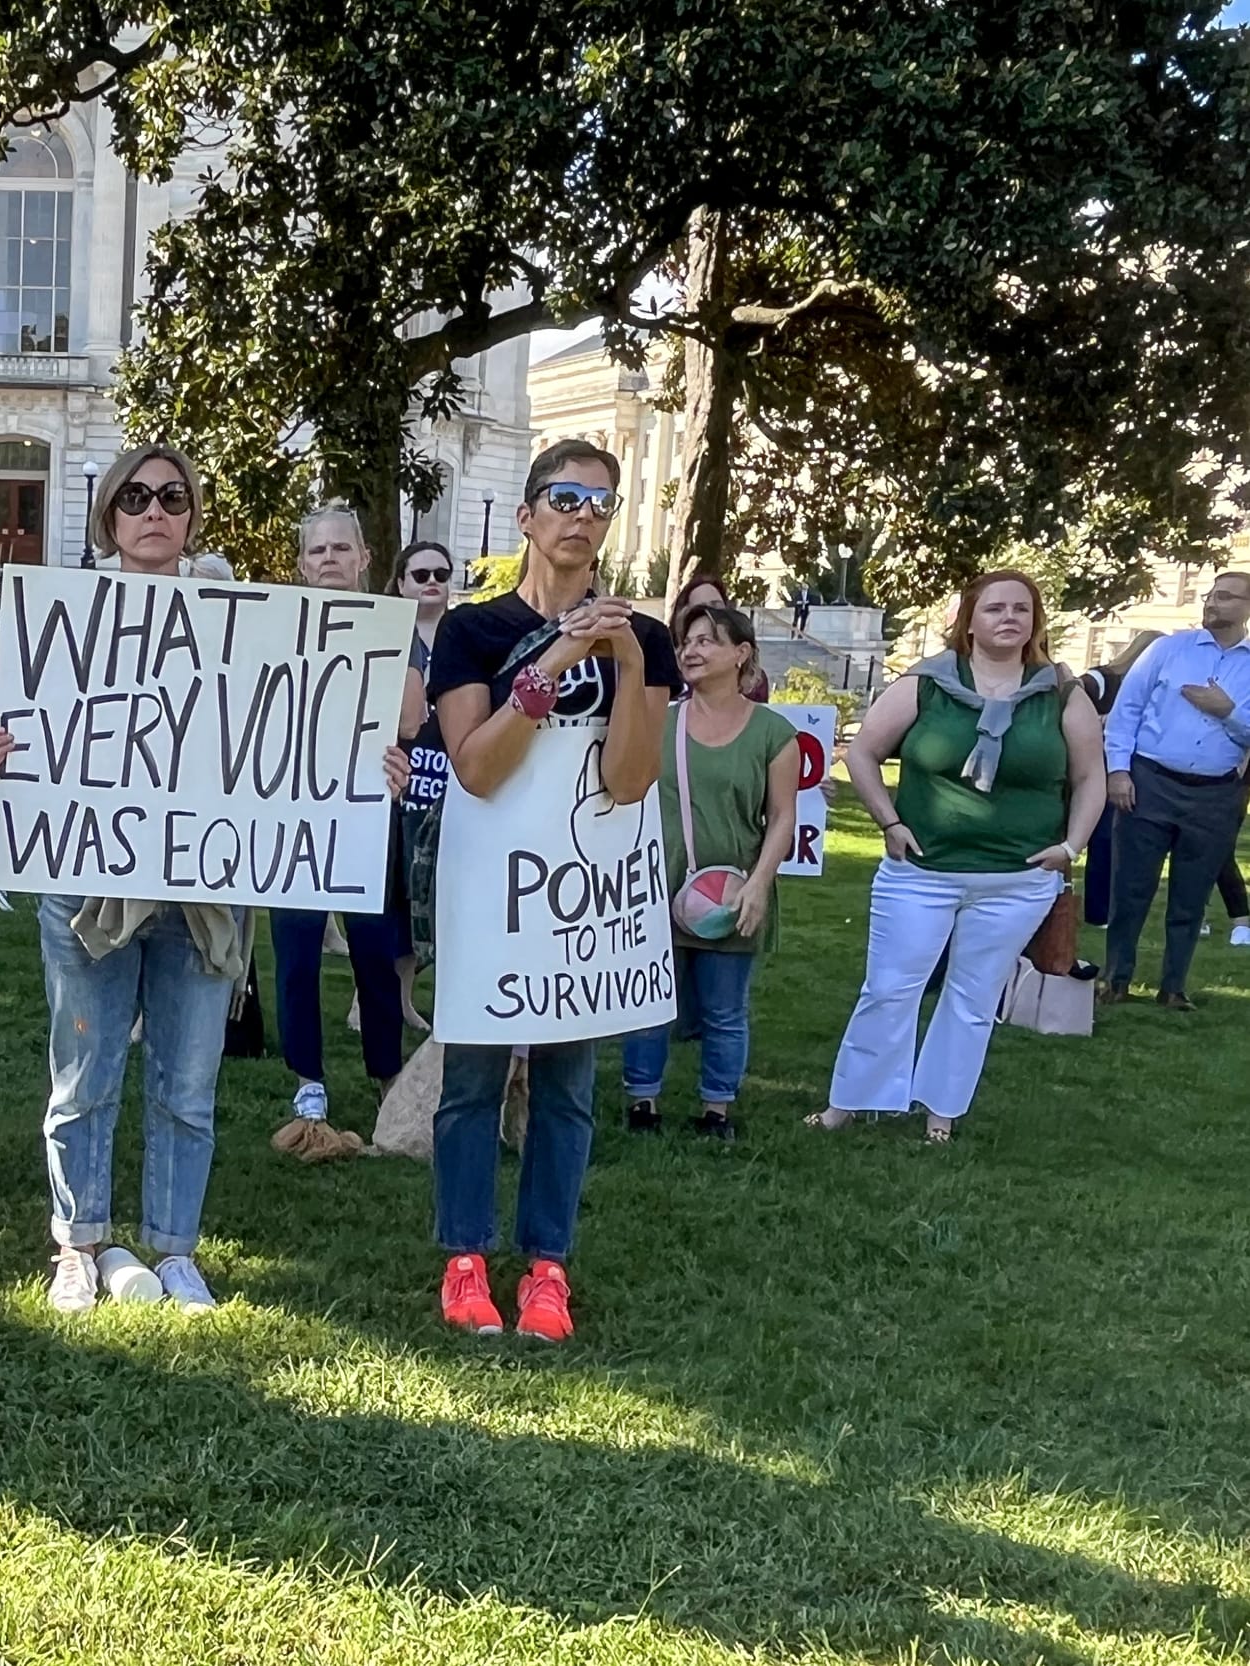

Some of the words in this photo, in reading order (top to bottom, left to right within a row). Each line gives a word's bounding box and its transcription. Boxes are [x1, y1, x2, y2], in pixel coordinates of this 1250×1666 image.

[12, 575, 270, 700] WHAT
[296, 597, 375, 656] IF
[217, 649, 403, 803] VOICE
[410, 746, 450, 773] STO
[410, 774, 447, 799] TEC
[2, 800, 148, 880] WAS
[163, 810, 367, 895] EQUAL
[507, 839, 665, 934] POWER
[553, 923, 597, 965] TO
[603, 908, 647, 954] THE
[485, 949, 673, 1020] SURVIVORS
